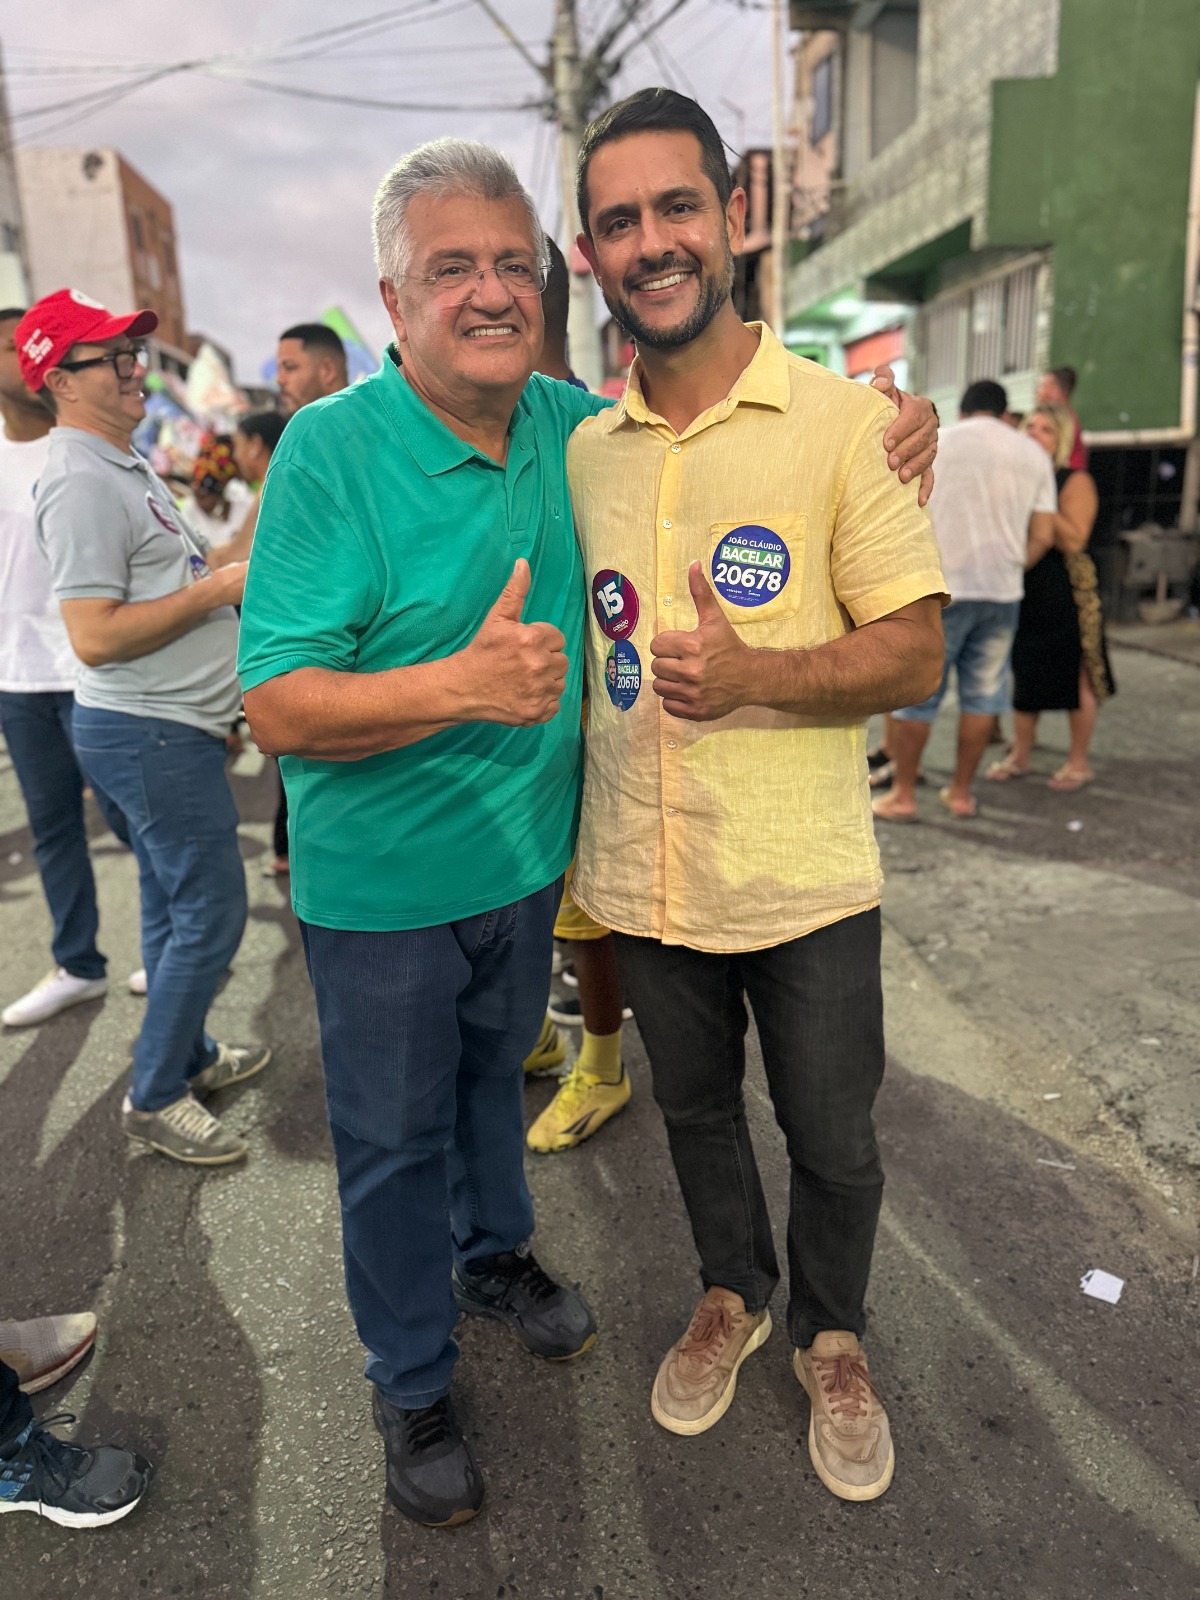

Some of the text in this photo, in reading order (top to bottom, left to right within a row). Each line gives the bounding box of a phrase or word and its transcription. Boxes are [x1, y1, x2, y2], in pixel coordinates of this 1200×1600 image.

[728, 537, 782, 551] JOÃO CLÁUDIO
[721, 545, 783, 569] BACELAR
[714, 562, 782, 592] 20678
[596, 580, 625, 619] 15
[617, 665, 639, 674] BACELAR
[616, 675, 640, 690] 20678
